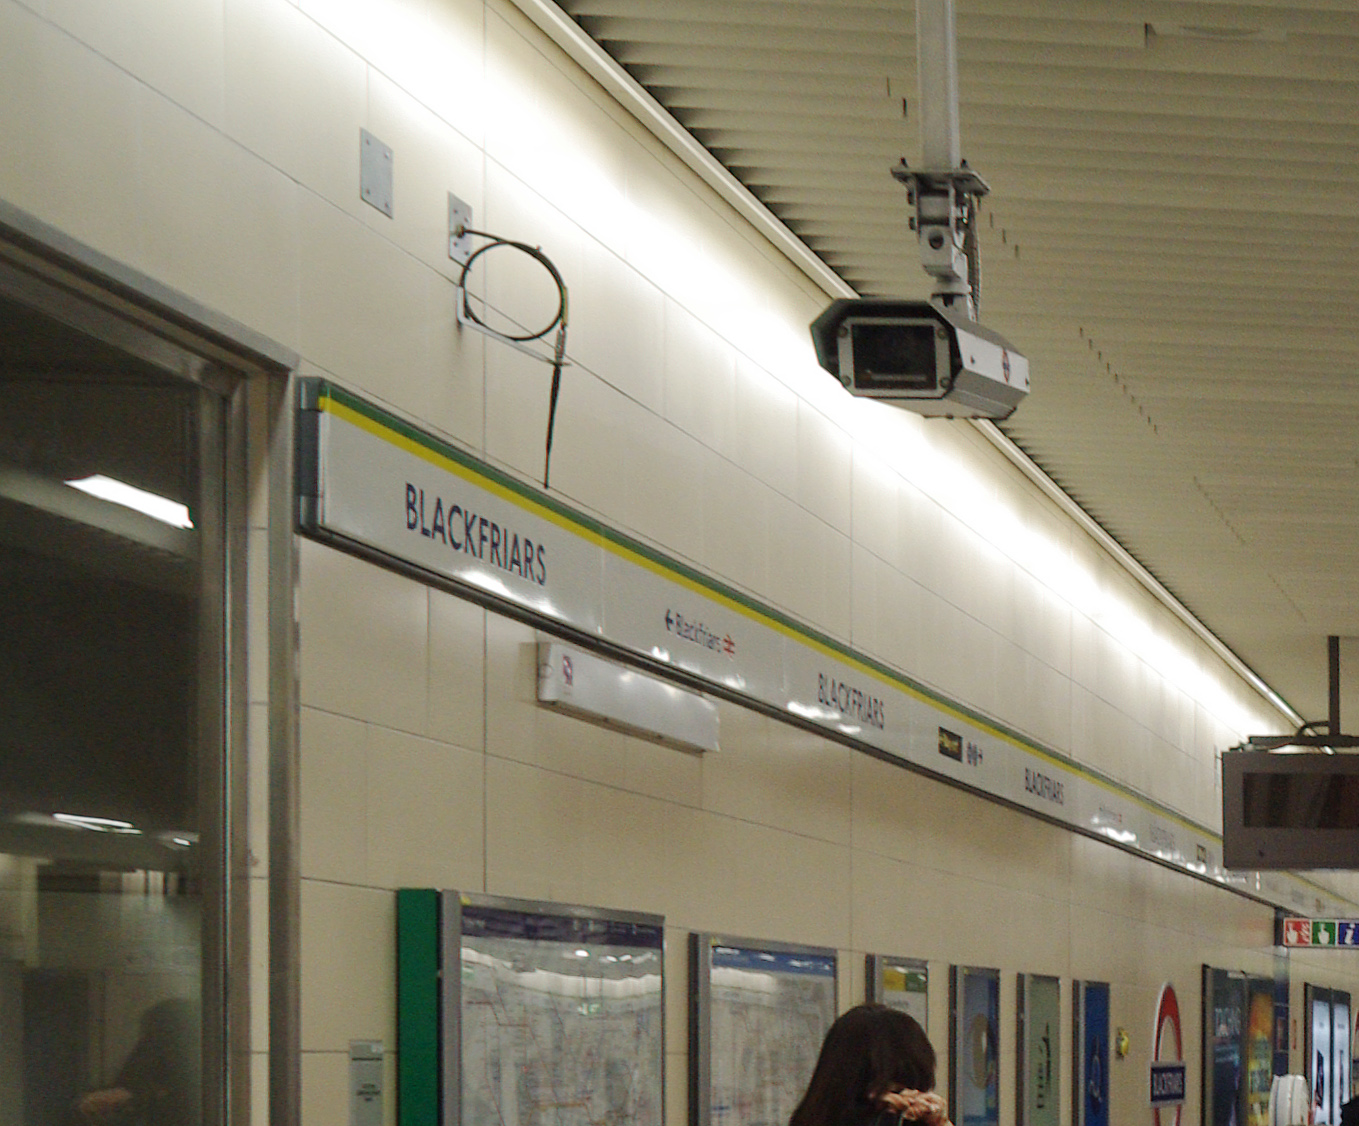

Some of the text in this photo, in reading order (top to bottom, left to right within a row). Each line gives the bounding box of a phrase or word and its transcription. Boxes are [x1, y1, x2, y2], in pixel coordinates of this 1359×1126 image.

[405, 481, 547, 586] BLACKFRIARS
[817, 672, 885, 730] BLACKFRIARS
[1024, 766, 1064, 806] BLACKFRIARS
